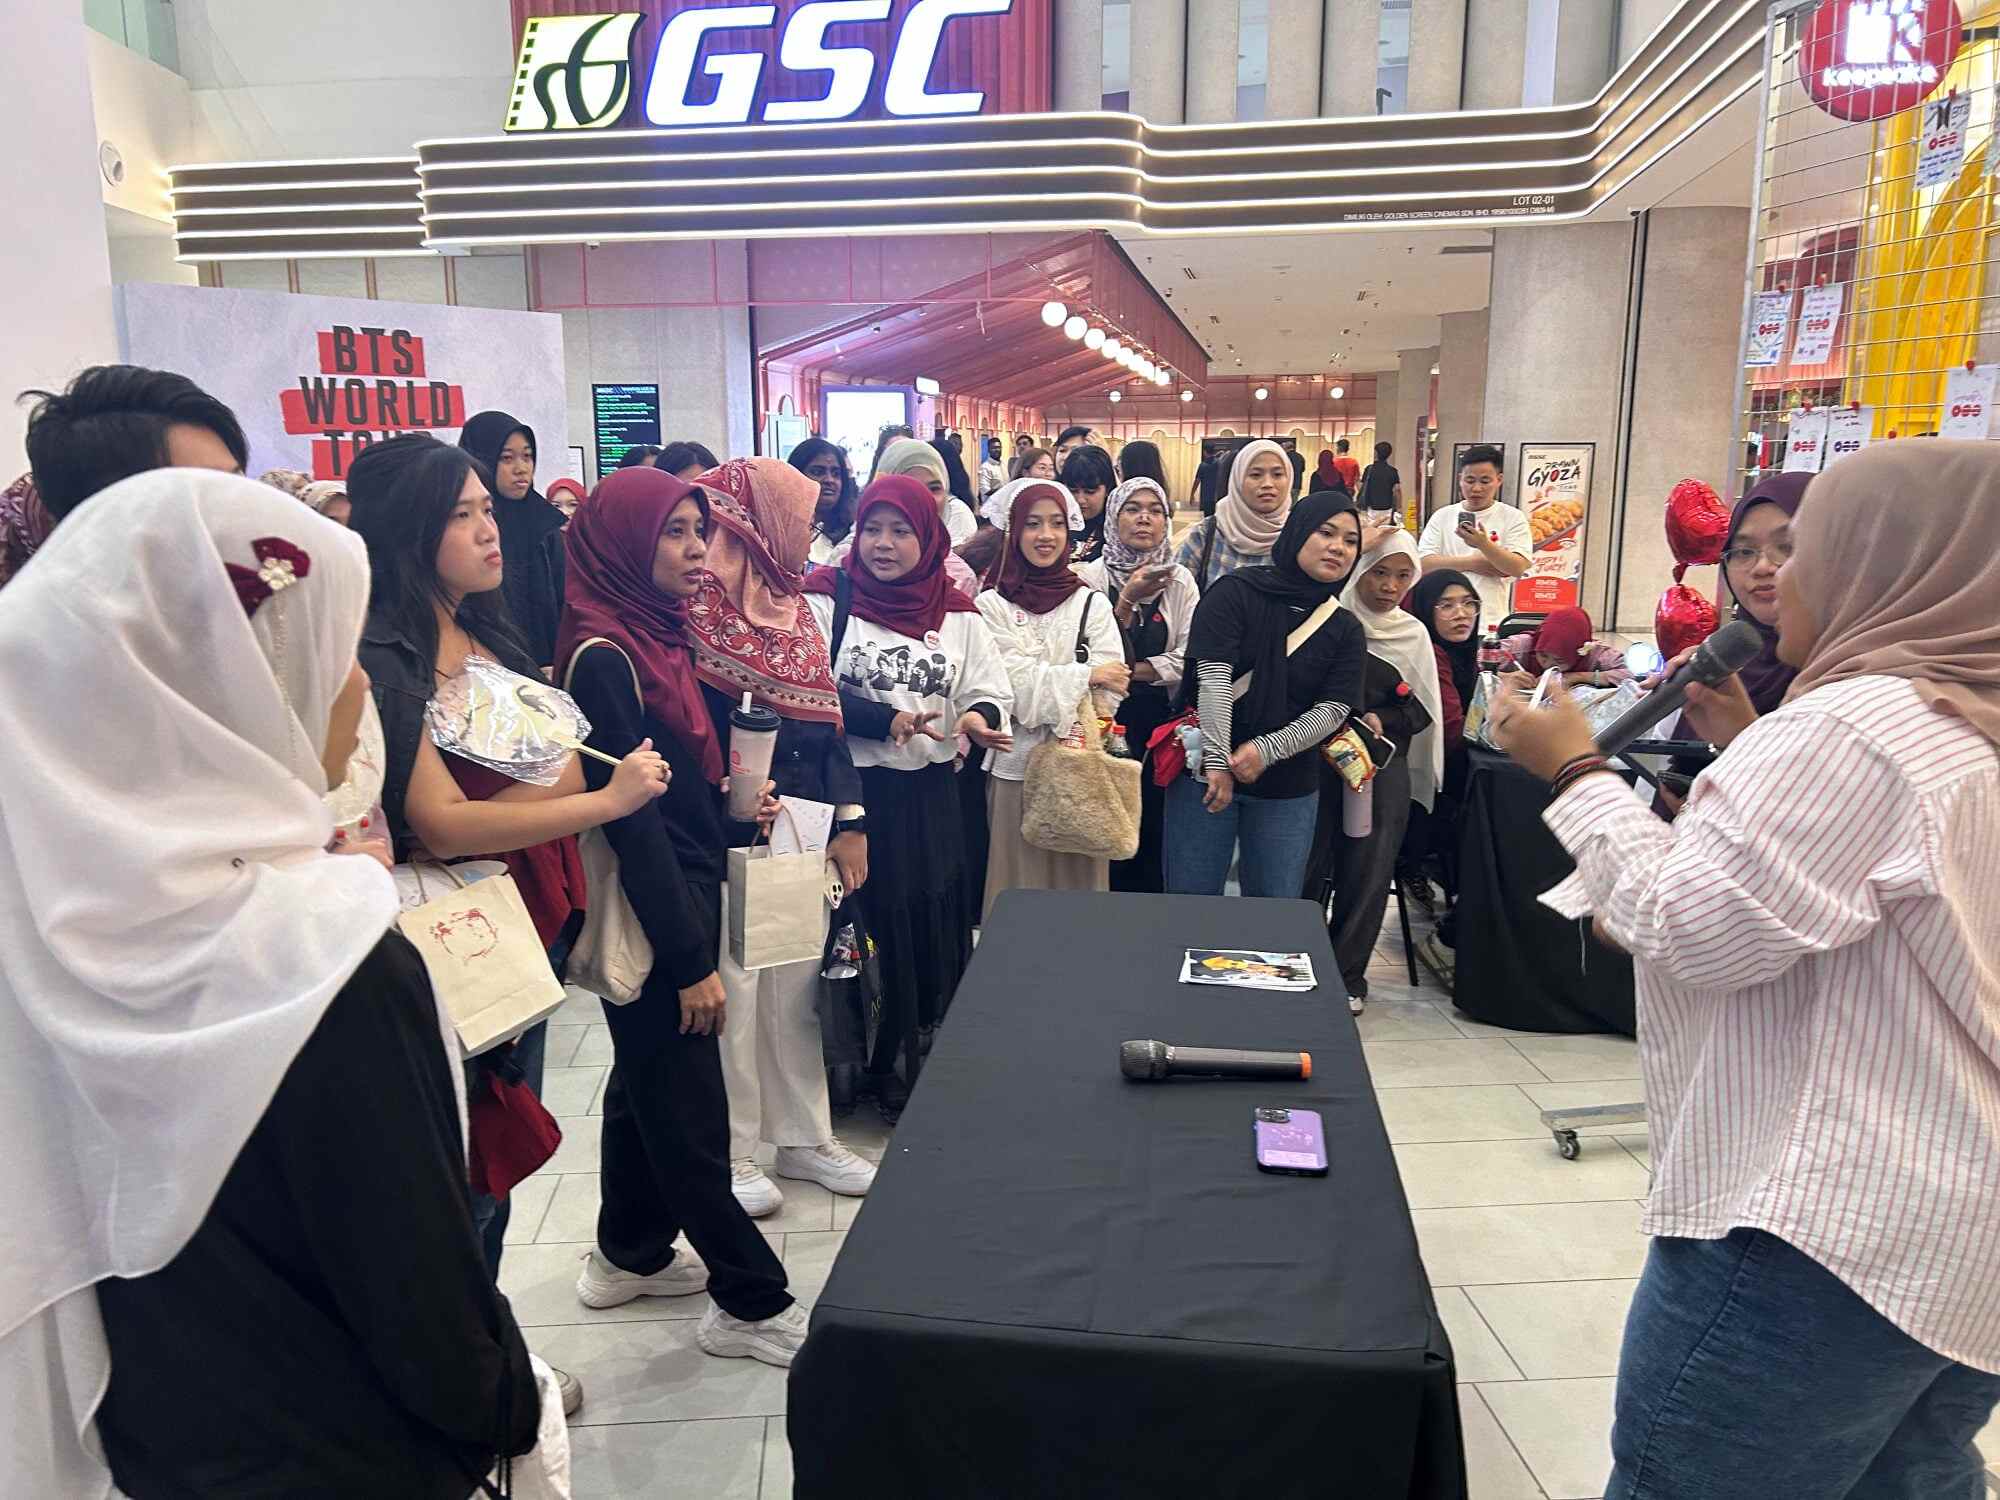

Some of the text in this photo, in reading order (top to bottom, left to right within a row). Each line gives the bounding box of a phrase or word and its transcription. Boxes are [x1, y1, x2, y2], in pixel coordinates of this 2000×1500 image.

[646, 0, 1009, 126] GSC
[1512, 195, 1555, 206] LOT 02-01
[332, 325, 413, 375] BTS
[299, 376, 450, 426] WORLD
[1527, 465, 1581, 487] GYOZA
